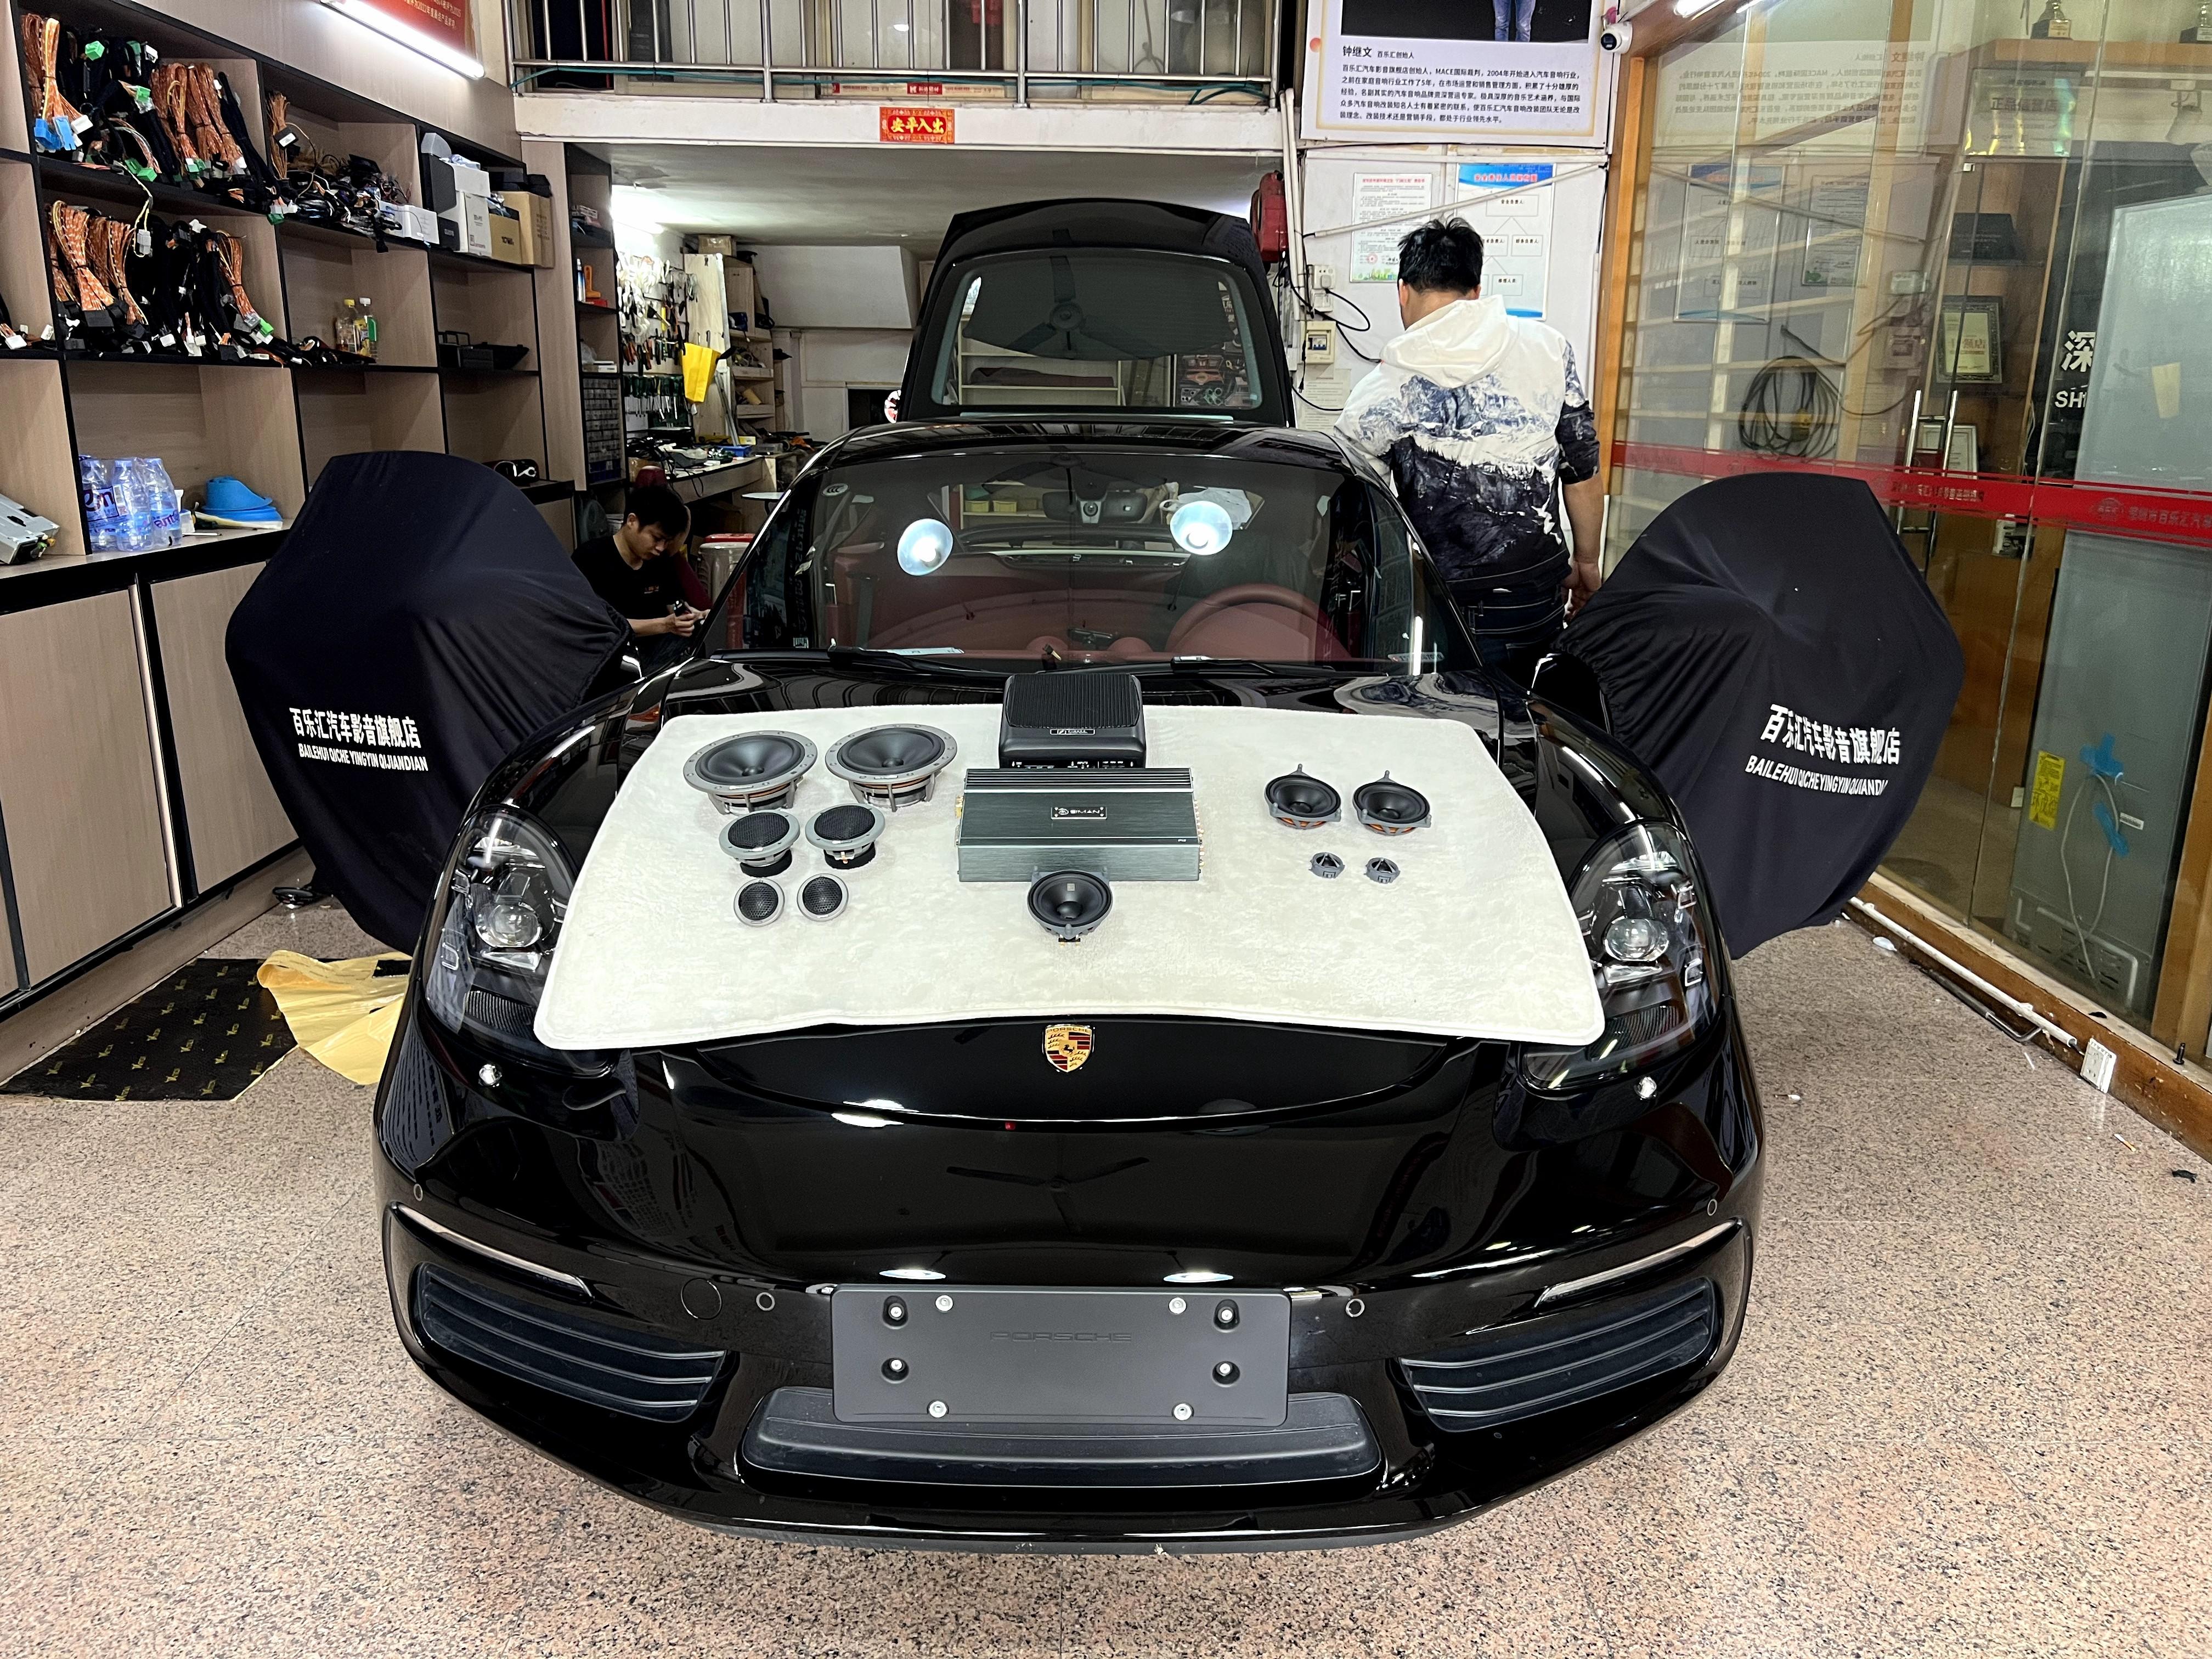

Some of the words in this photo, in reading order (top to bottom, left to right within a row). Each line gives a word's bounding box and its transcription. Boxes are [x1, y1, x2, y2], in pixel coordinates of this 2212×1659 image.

[1342, 46, 1373, 59] 钟继文
[1377, 50, 1415, 60] 百乐汇创始人
[289, 707, 422, 749] 百乐汇汽车影音旗舰店
[298, 743, 330, 761] BAILEHUI
[329, 747, 351, 764] QICHE
[349, 750, 379, 768] YINGYIN
[379, 754, 429, 771] QIJIANDIAN
[1745, 755, 1798, 786] BAILEHUI
[1798, 769, 1820, 791] QICHE
[1819, 774, 1849, 794] YINGYIN
[990, 1331, 1132, 1343] PORSCHE
